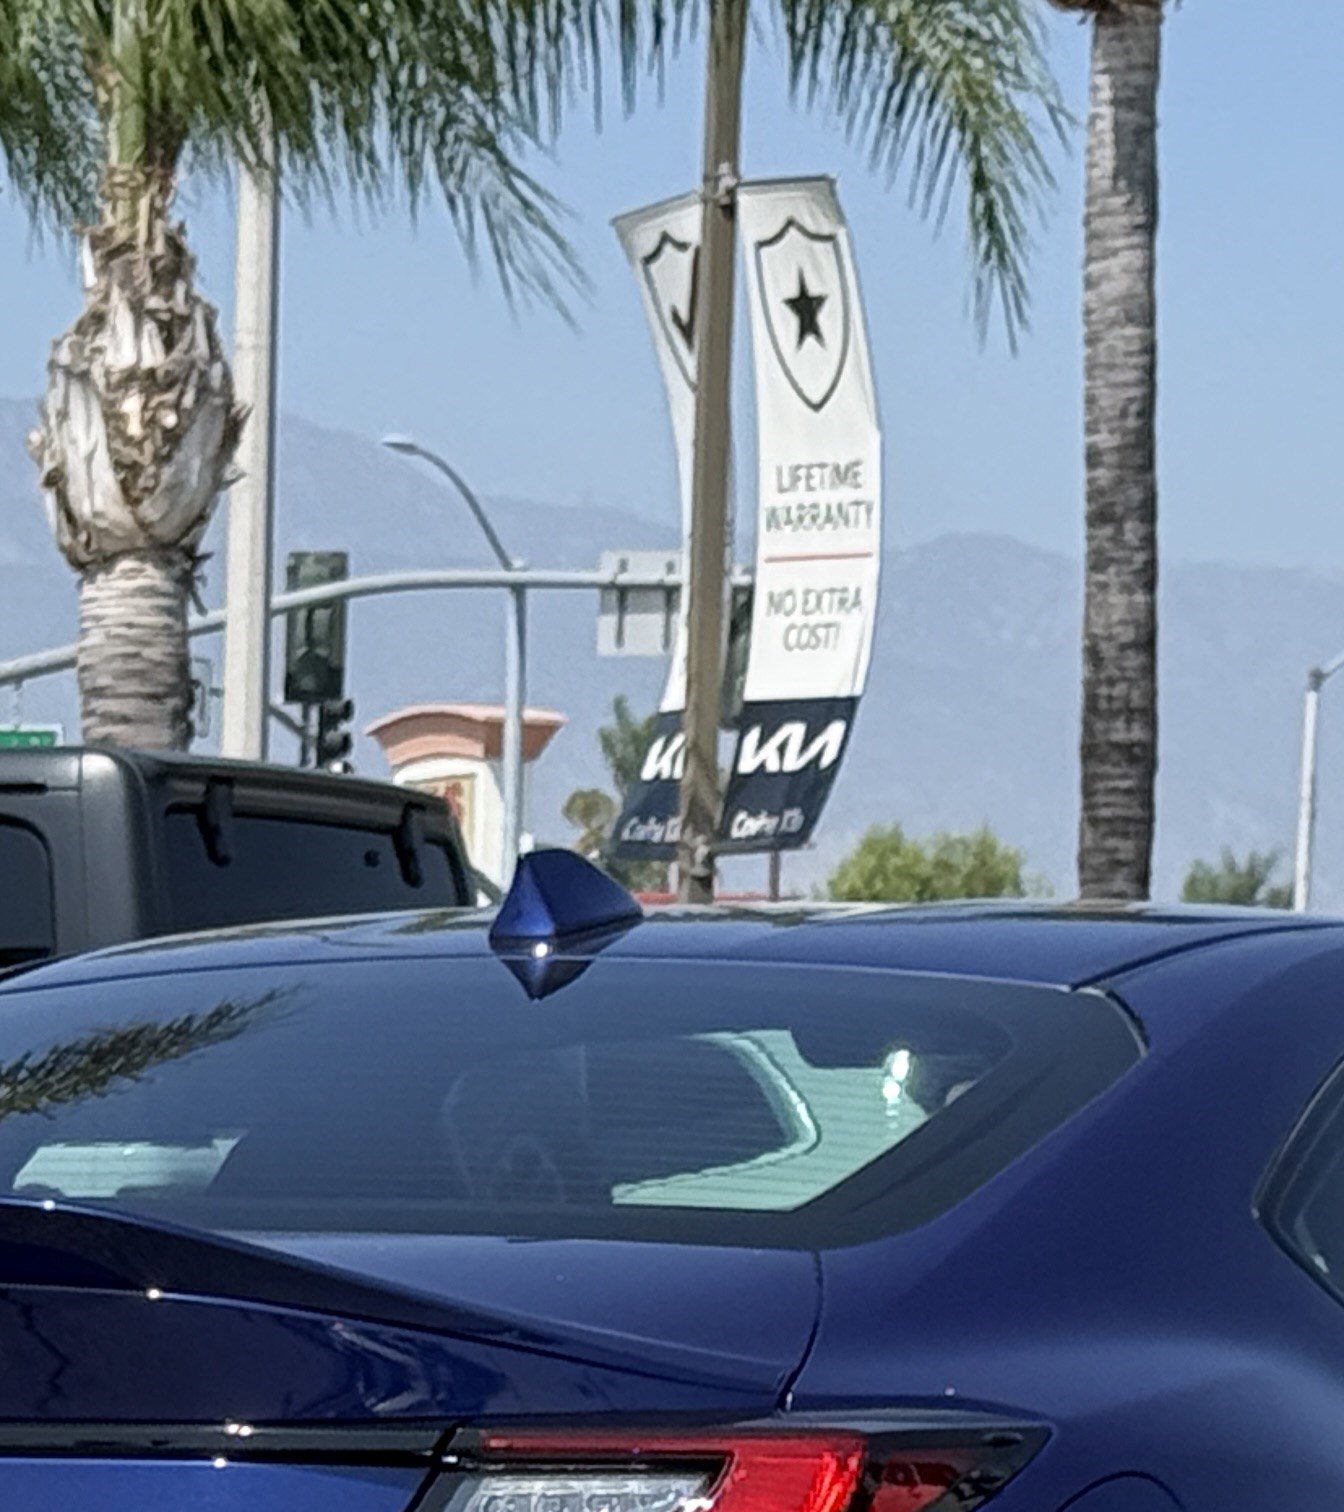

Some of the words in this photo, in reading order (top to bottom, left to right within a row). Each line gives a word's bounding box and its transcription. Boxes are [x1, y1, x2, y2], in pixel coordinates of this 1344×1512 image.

[776, 458, 864, 494] LIFETIME
[765, 500, 874, 532] WARRANTY
[766, 588, 796, 618] NO
[802, 586, 863, 617] EXTRA
[737, 719, 846, 774] KIA
